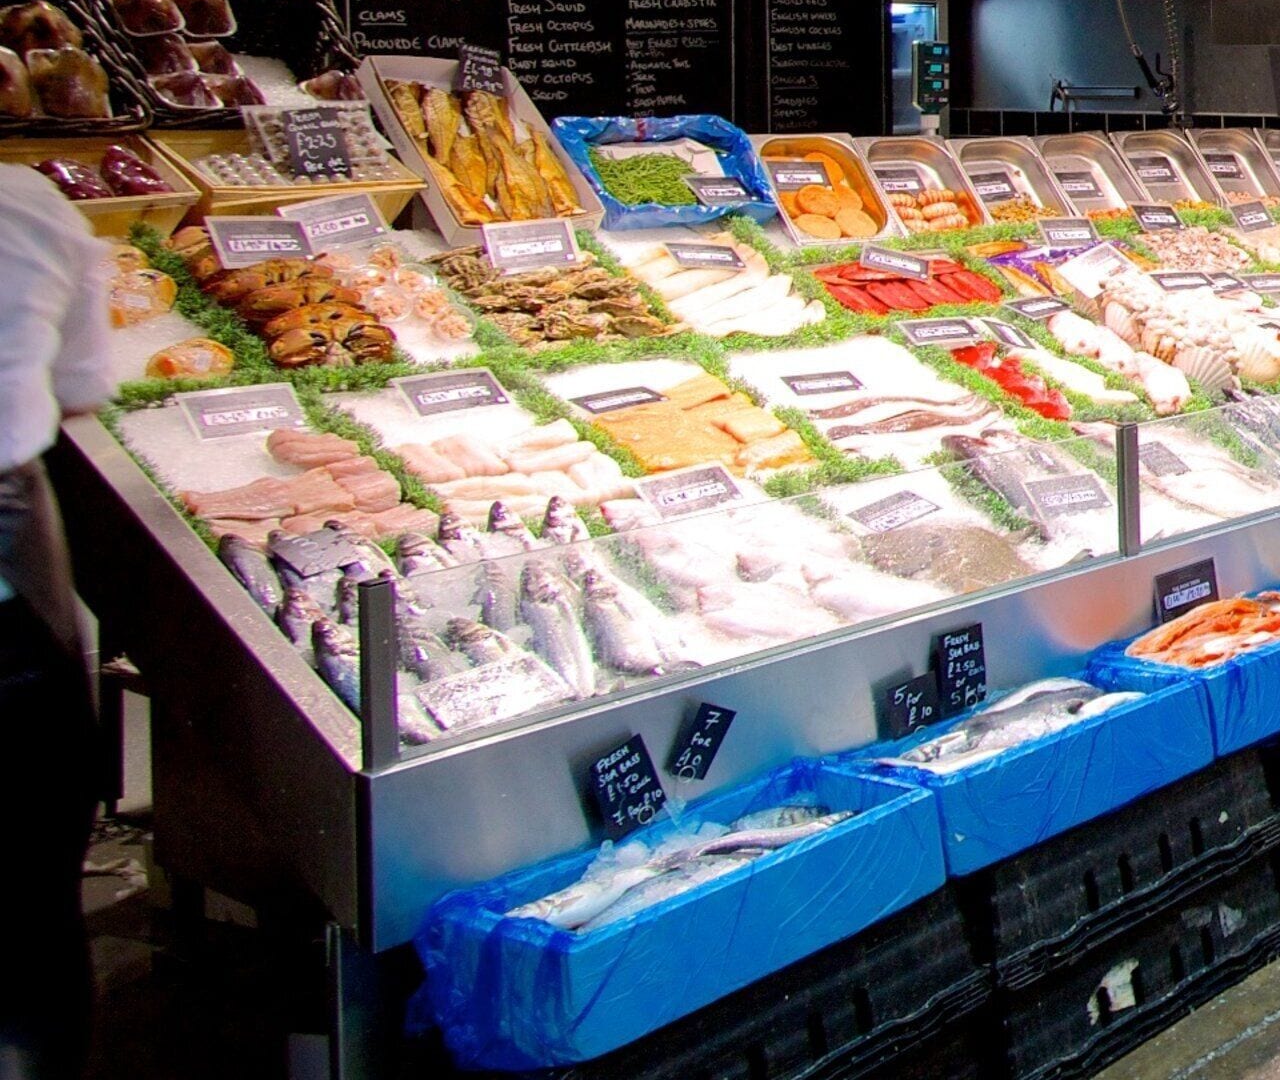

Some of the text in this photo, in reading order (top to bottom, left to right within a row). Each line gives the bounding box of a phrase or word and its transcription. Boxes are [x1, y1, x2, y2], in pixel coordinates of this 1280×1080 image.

[358, 9, 406, 23] CLAMS
[507, 16, 596, 35] FRESH OCTOPUS
[352, 31, 423, 50] PALOURDE
[508, 36, 544, 54] FRESH
[943, 632, 970, 649] FRESH
[893, 684, 909, 705] 5
[704, 710, 723, 731] 7
[596, 744, 631, 774] FRESH
[599, 752, 641, 788] SEA BASS
